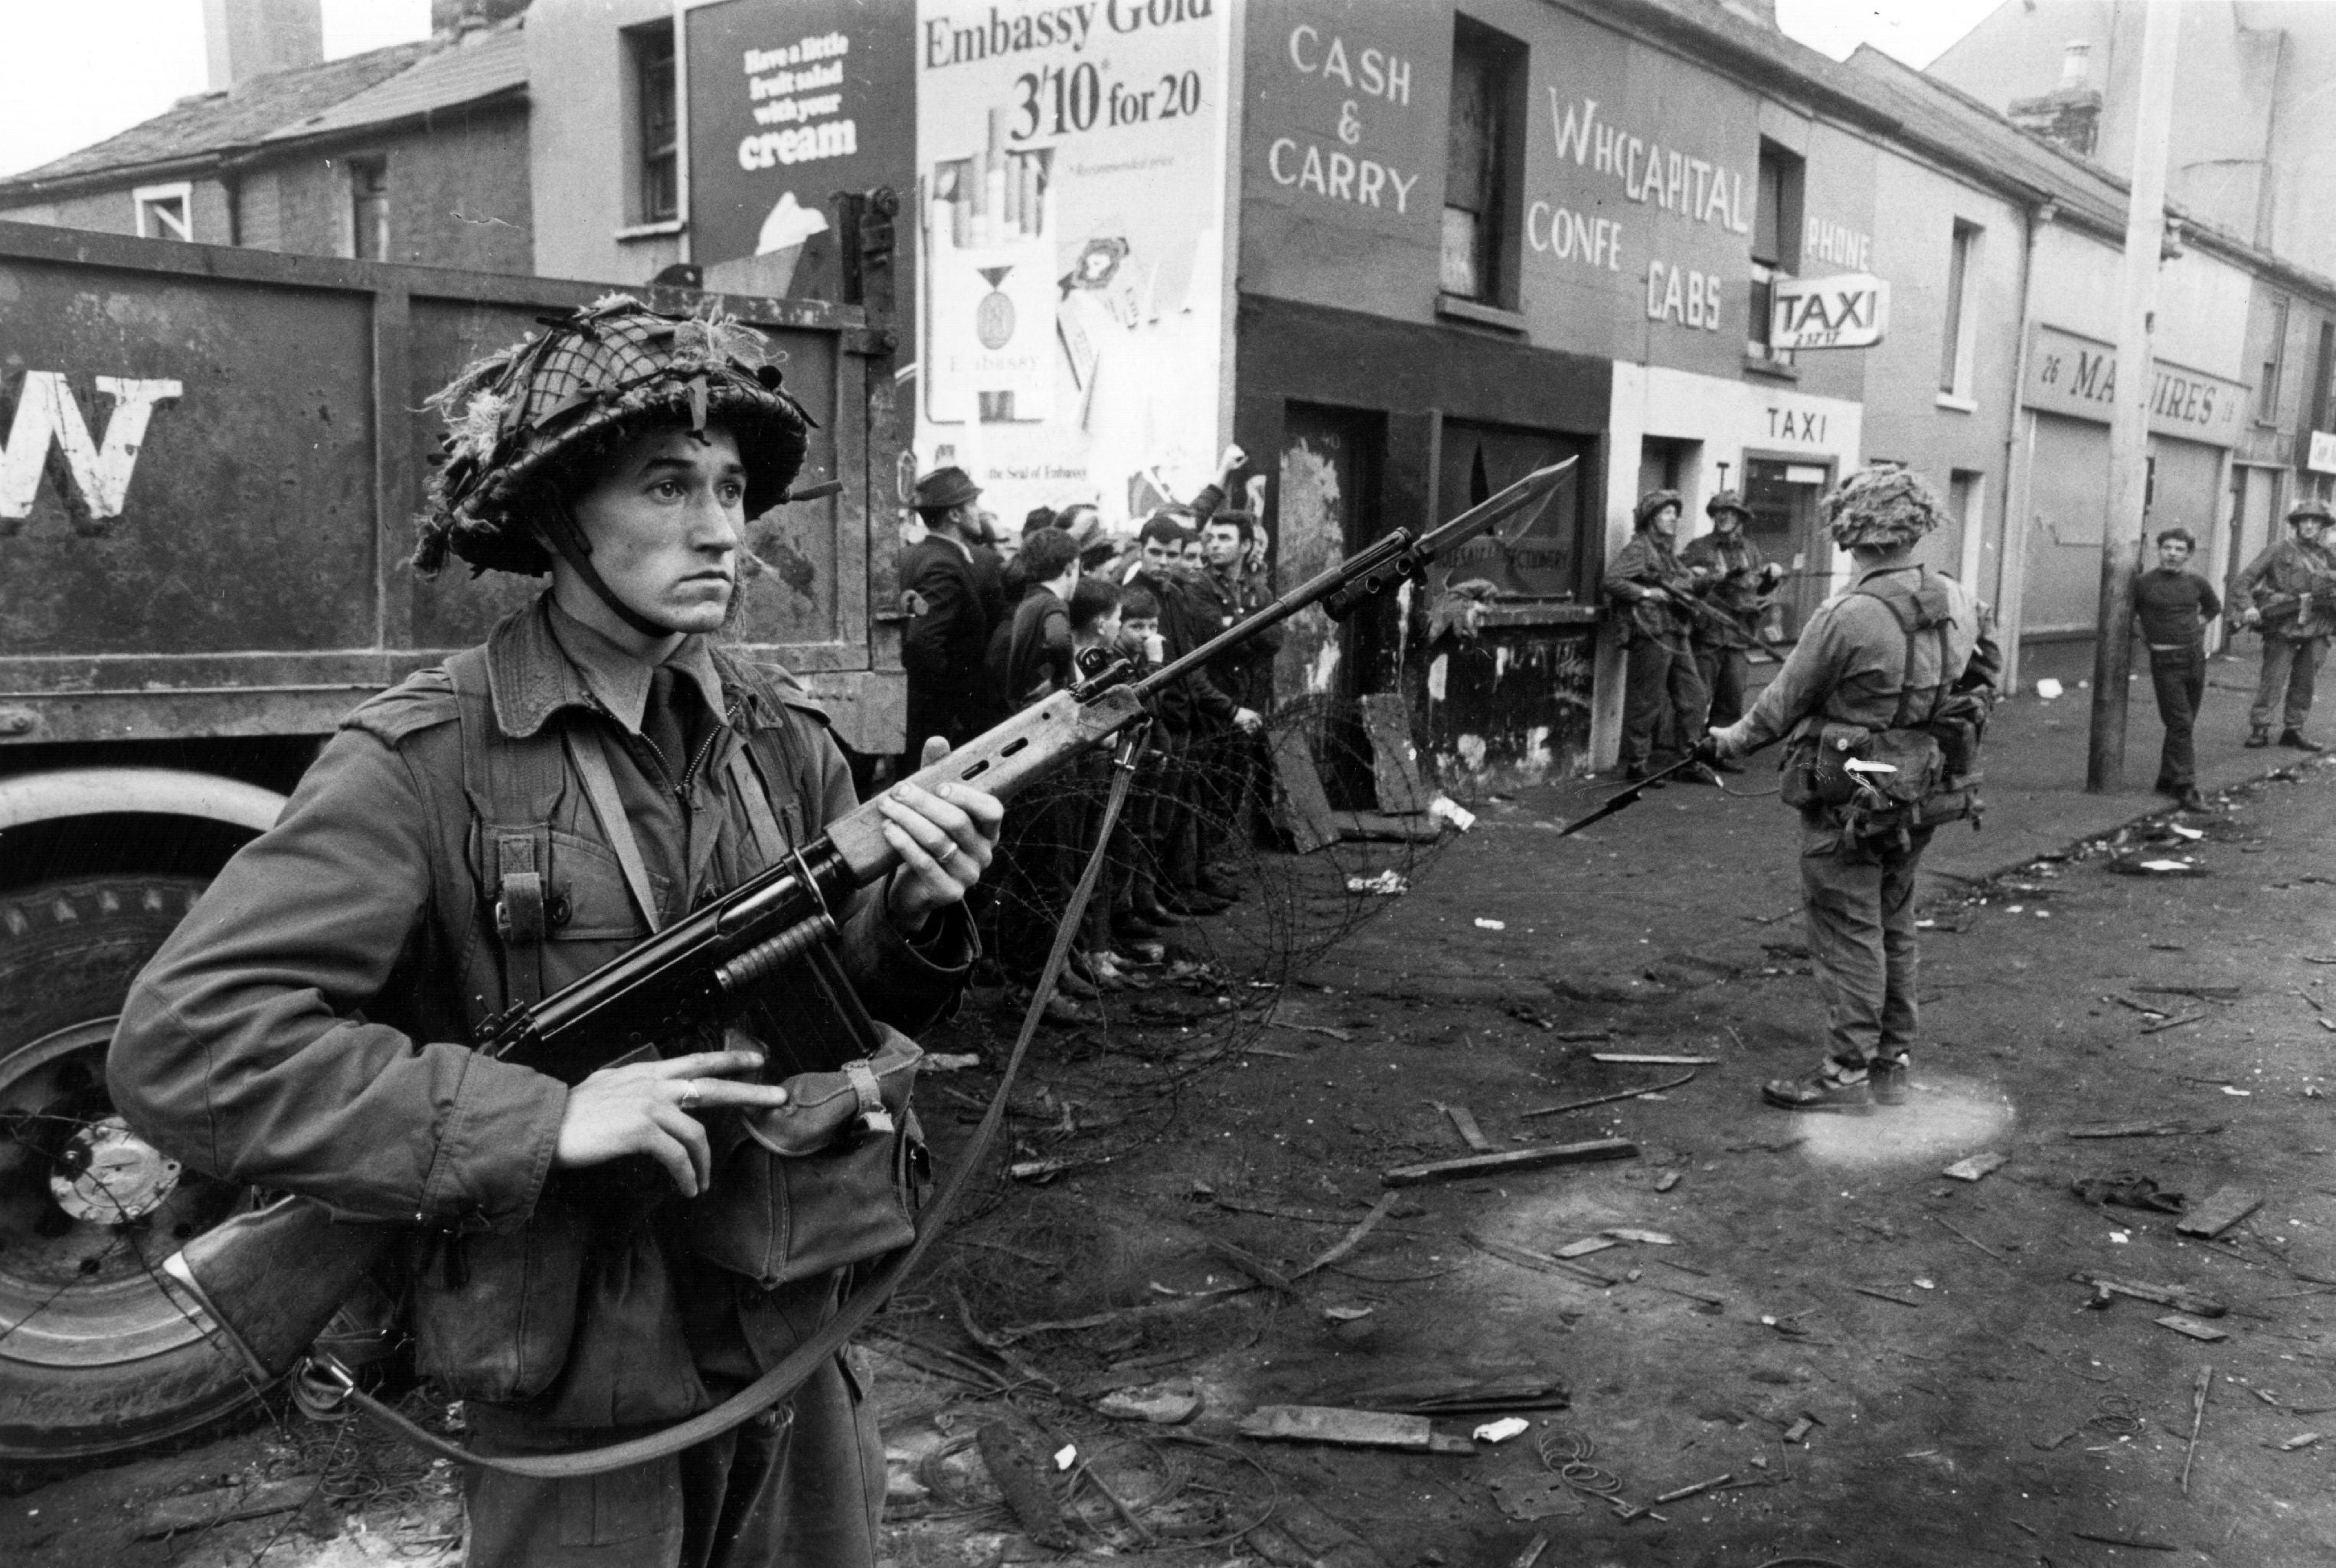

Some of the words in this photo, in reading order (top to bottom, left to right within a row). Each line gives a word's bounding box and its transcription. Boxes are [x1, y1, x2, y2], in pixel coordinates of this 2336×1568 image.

[925, 2, 1096, 70] Embassy
[1289, 24, 1411, 106] CASH
[1109, 82, 1156, 127] for
[1158, 70, 1201, 120] 20
[1338, 100, 1361, 145] &
[738, 118, 858, 171] cream
[1269, 137, 1420, 215] CARRY
[1625, 136, 1749, 234] CAPITAL
[1807, 217, 1870, 272] PHONE
[1646, 259, 1721, 331] CABS
[1776, 290, 1877, 332] TAXI
[1766, 407, 1827, 443] TAXI
